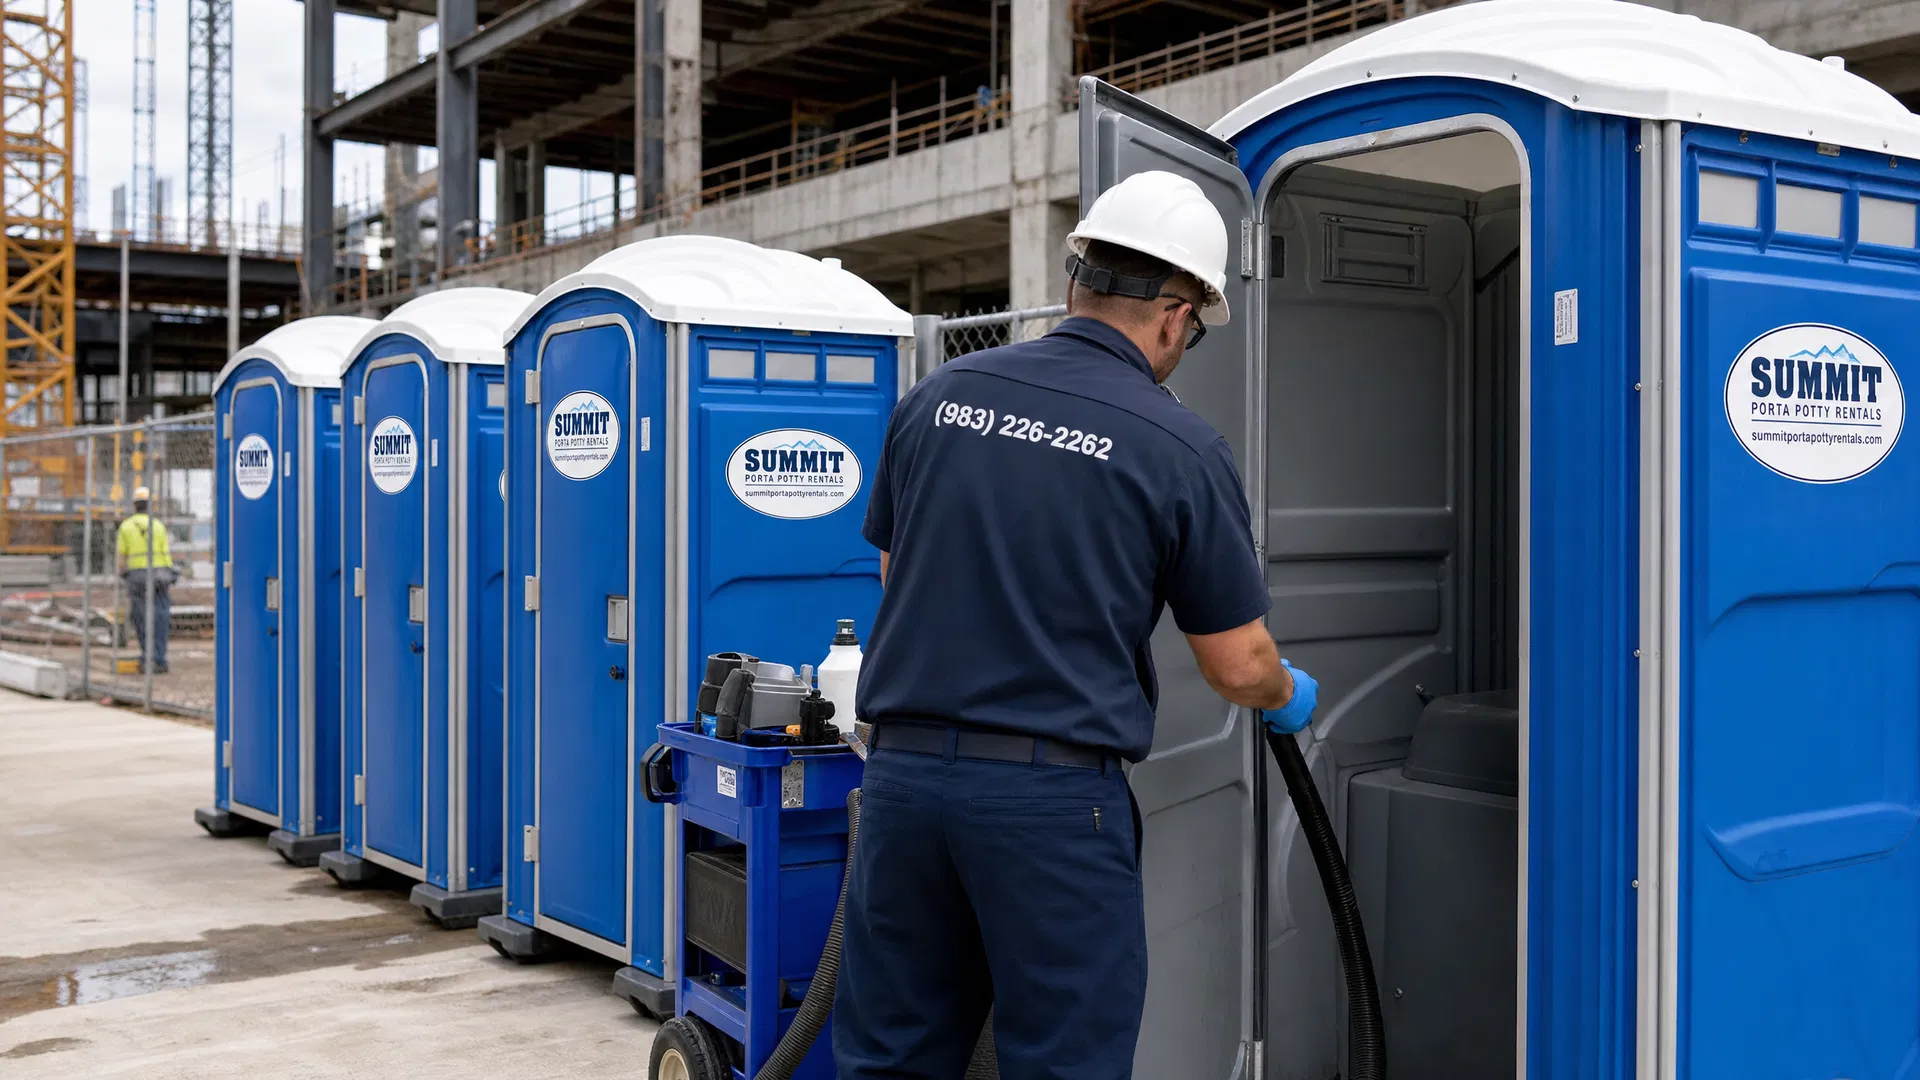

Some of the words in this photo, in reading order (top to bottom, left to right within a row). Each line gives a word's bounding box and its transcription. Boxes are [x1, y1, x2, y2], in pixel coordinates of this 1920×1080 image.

[1751, 356, 1882, 403] SUMMIT
[1751, 402, 1790, 416] PORTA
[1795, 405, 1831, 418] POTTY
[1835, 407, 1882, 421] RENTALS
[555, 411, 610, 437] SUMMIT
[935, 401, 995, 436] (983)
[998, 414, 1113, 461] 226-2262
[374, 434, 411, 456] SUMMIT
[571, 438, 585, 446] POTTY
[587, 437, 609, 446] RENTALS
[1752, 430, 1882, 445] summitportapottyrentals.com
[239, 449, 269, 468] SUMMIT
[744, 448, 844, 474] SUMMIT
[745, 474, 774, 483] PORTA
[777, 474, 805, 483] POTTY
[808, 475, 844, 484] RENTALS
[745, 489, 844, 498] summitportapottyrentals.com
